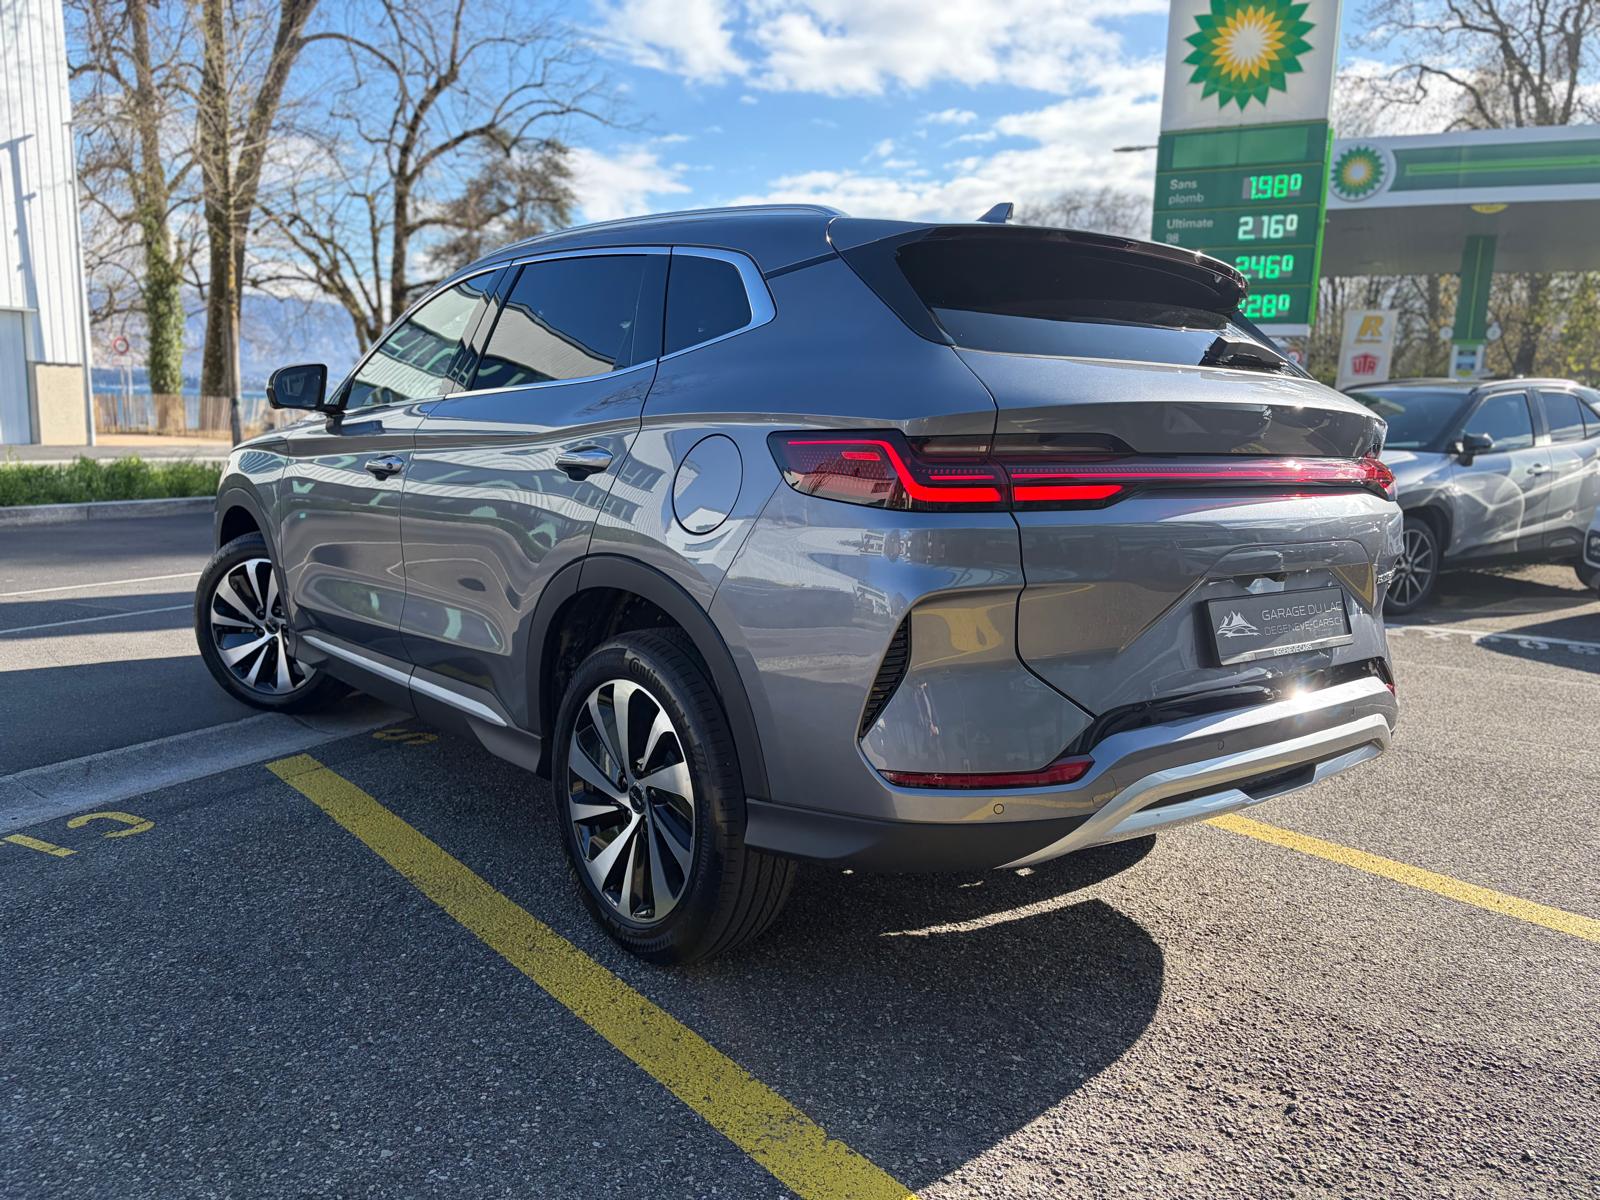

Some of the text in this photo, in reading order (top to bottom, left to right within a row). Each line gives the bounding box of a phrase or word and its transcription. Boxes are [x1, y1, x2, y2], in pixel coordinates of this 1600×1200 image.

[1169, 178, 1198, 190] Sans
[1168, 192, 1205, 206] plomb
[1166, 217, 1214, 230] Ultimate
[1261, 600, 1343, 621] GARAGE DU LAC
